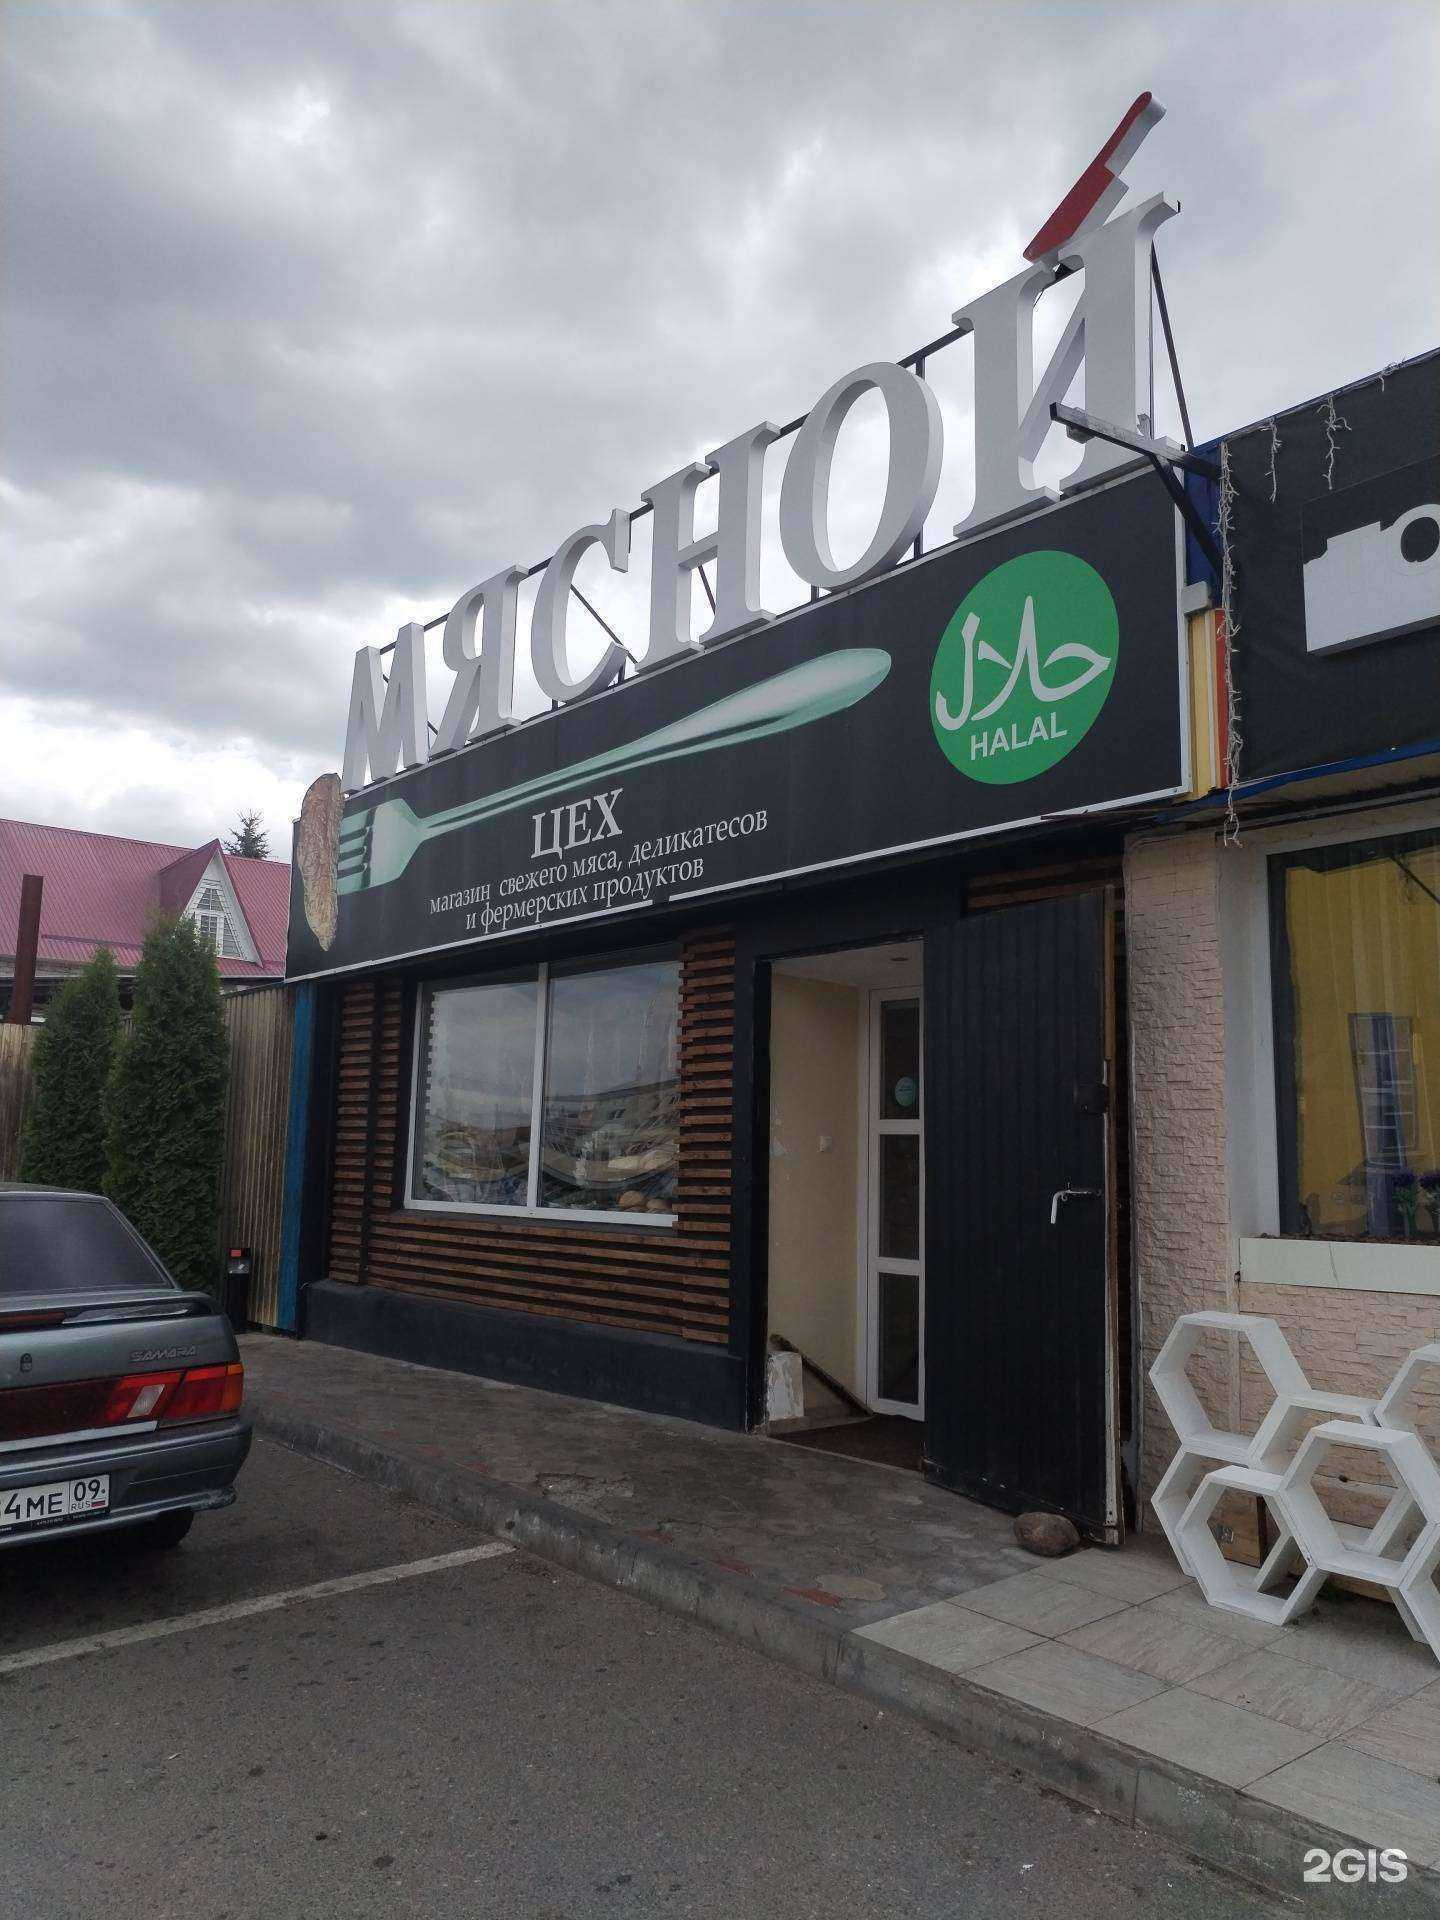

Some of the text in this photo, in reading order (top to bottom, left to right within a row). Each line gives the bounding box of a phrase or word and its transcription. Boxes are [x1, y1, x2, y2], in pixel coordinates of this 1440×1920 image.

[341, 92, 1181, 794] МЯСНОЙ
[935, 595, 1111, 731] حلال
[970, 711, 1068, 761] HALAL
[530, 788, 624, 860] ЦЕХ
[430, 810, 768, 914] магазин свежего мяса, деликатесов
[466, 858, 704, 934] и фермерских продуктов
[71, 1500, 91, 1511] RUS
[74, 1479, 101, 1502] 09
